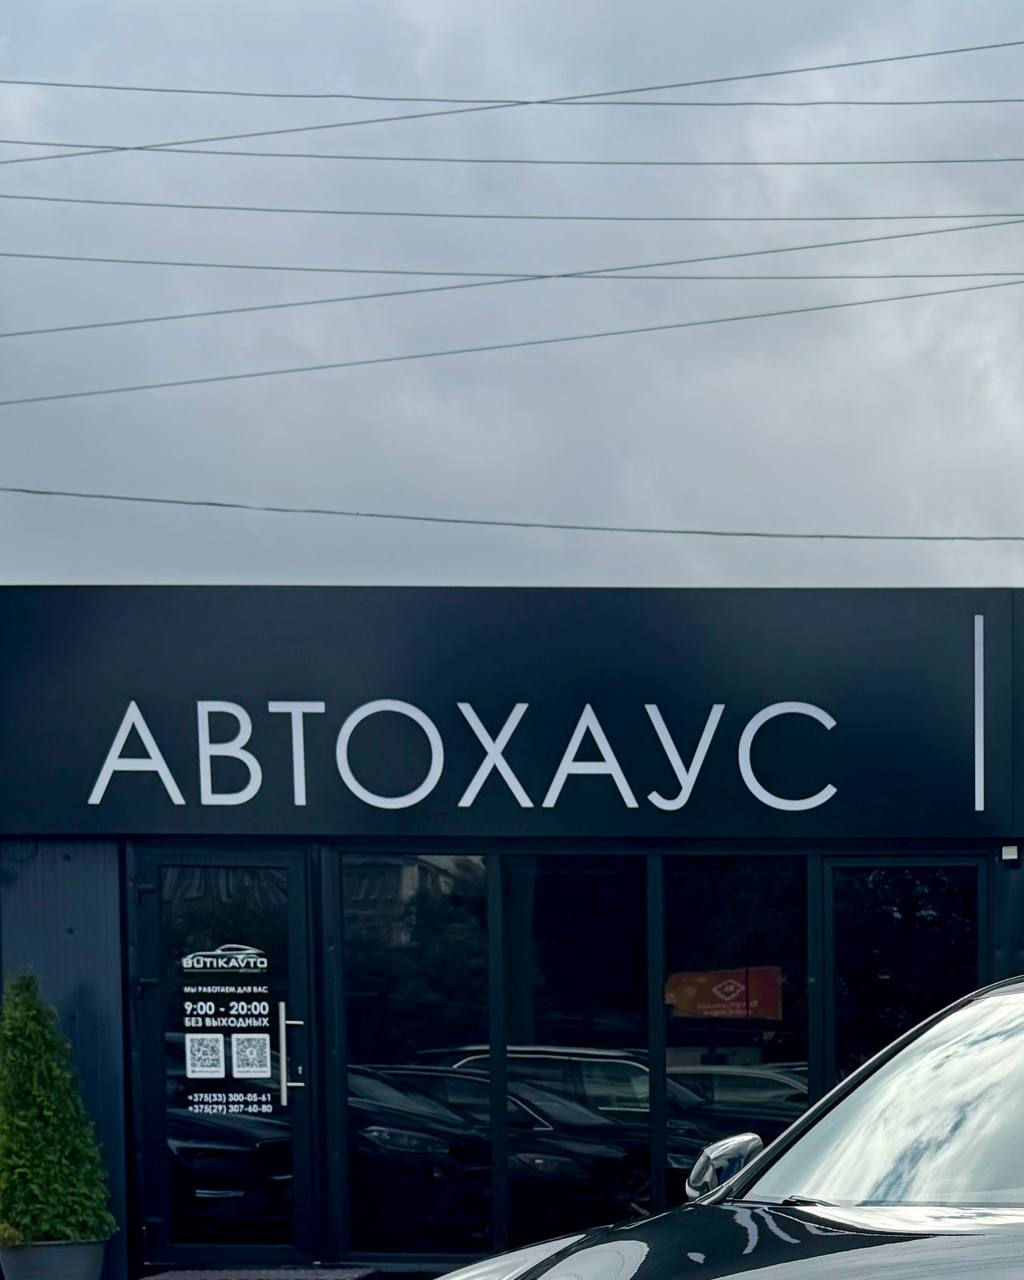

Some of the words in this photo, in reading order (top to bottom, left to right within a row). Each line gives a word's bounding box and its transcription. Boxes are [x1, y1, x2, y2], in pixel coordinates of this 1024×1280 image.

[88, 699, 839, 812] АВТОХАУС
[183, 957, 268, 968] BUTIKAVTO
[184, 1001, 216, 1015] 9:00
[229, 1001, 269, 1015] 20:00
[184, 1017, 203, 1027] БЕЗ
[205, 1017, 269, 1028] ВЫХОДНЫХ
